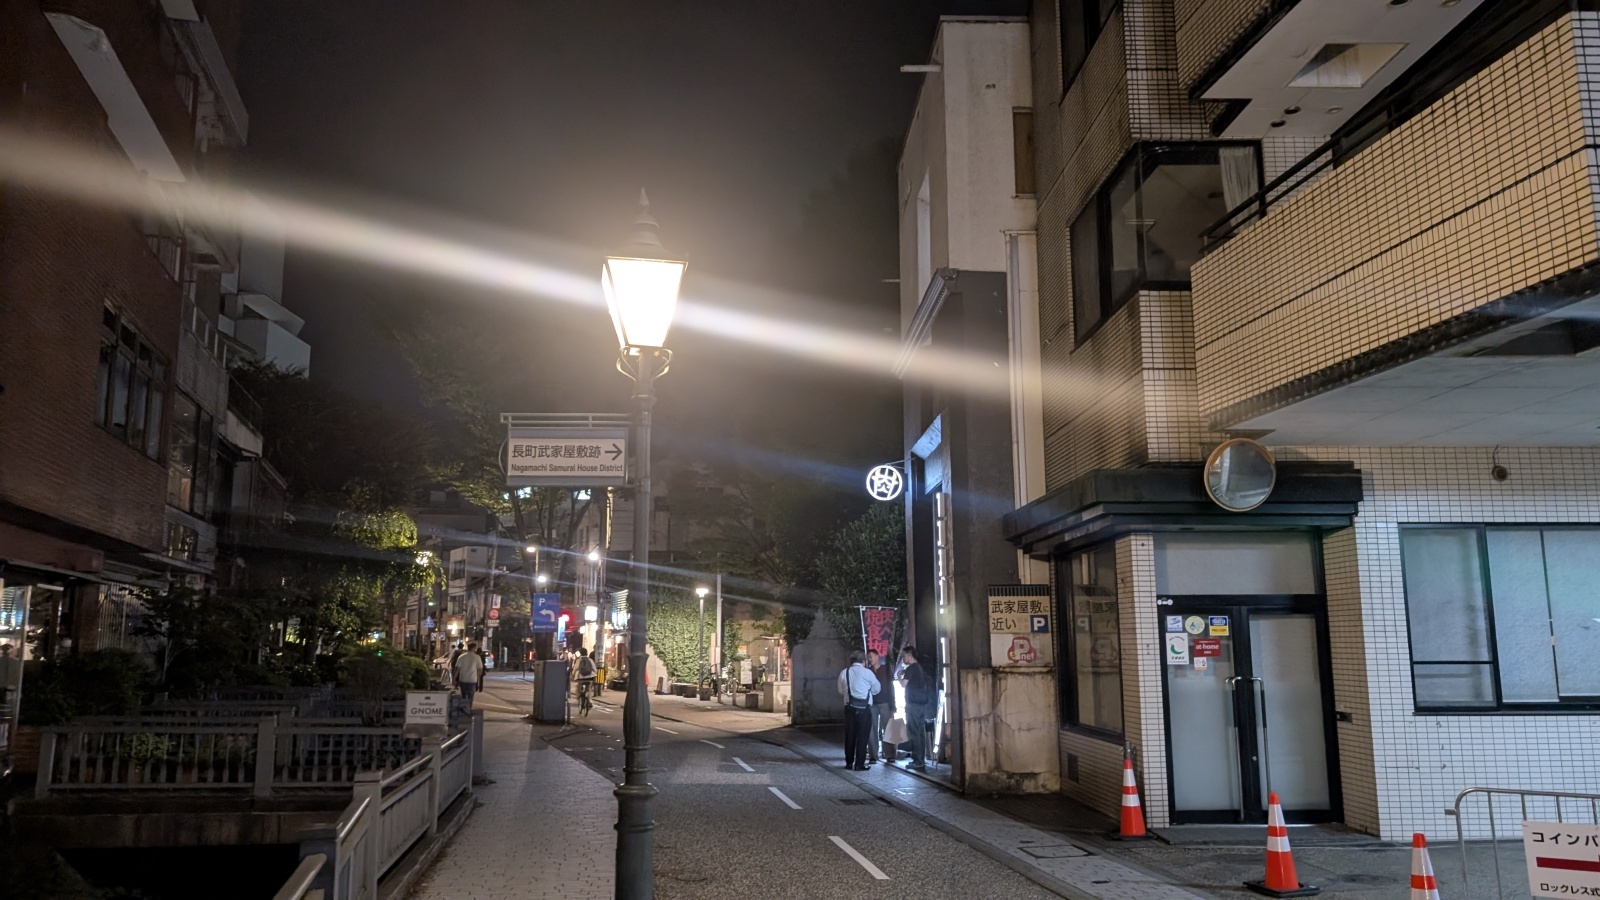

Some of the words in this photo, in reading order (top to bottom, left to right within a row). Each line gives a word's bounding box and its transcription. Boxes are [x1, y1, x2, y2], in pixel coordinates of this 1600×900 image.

[511, 444, 602, 459] 長町武家屋敷跡
[511, 463, 548, 473] Nagamachi
[548, 463, 576, 472] Samurai
[577, 463, 598, 472] House
[599, 463, 623, 472] District
[538, 597, 546, 607] P
[991, 600, 1049, 614] 武家屋敷に
[991, 617, 1017, 631] 近い
[1033, 617, 1045, 631] P
[410, 707, 443, 715] GNOME
